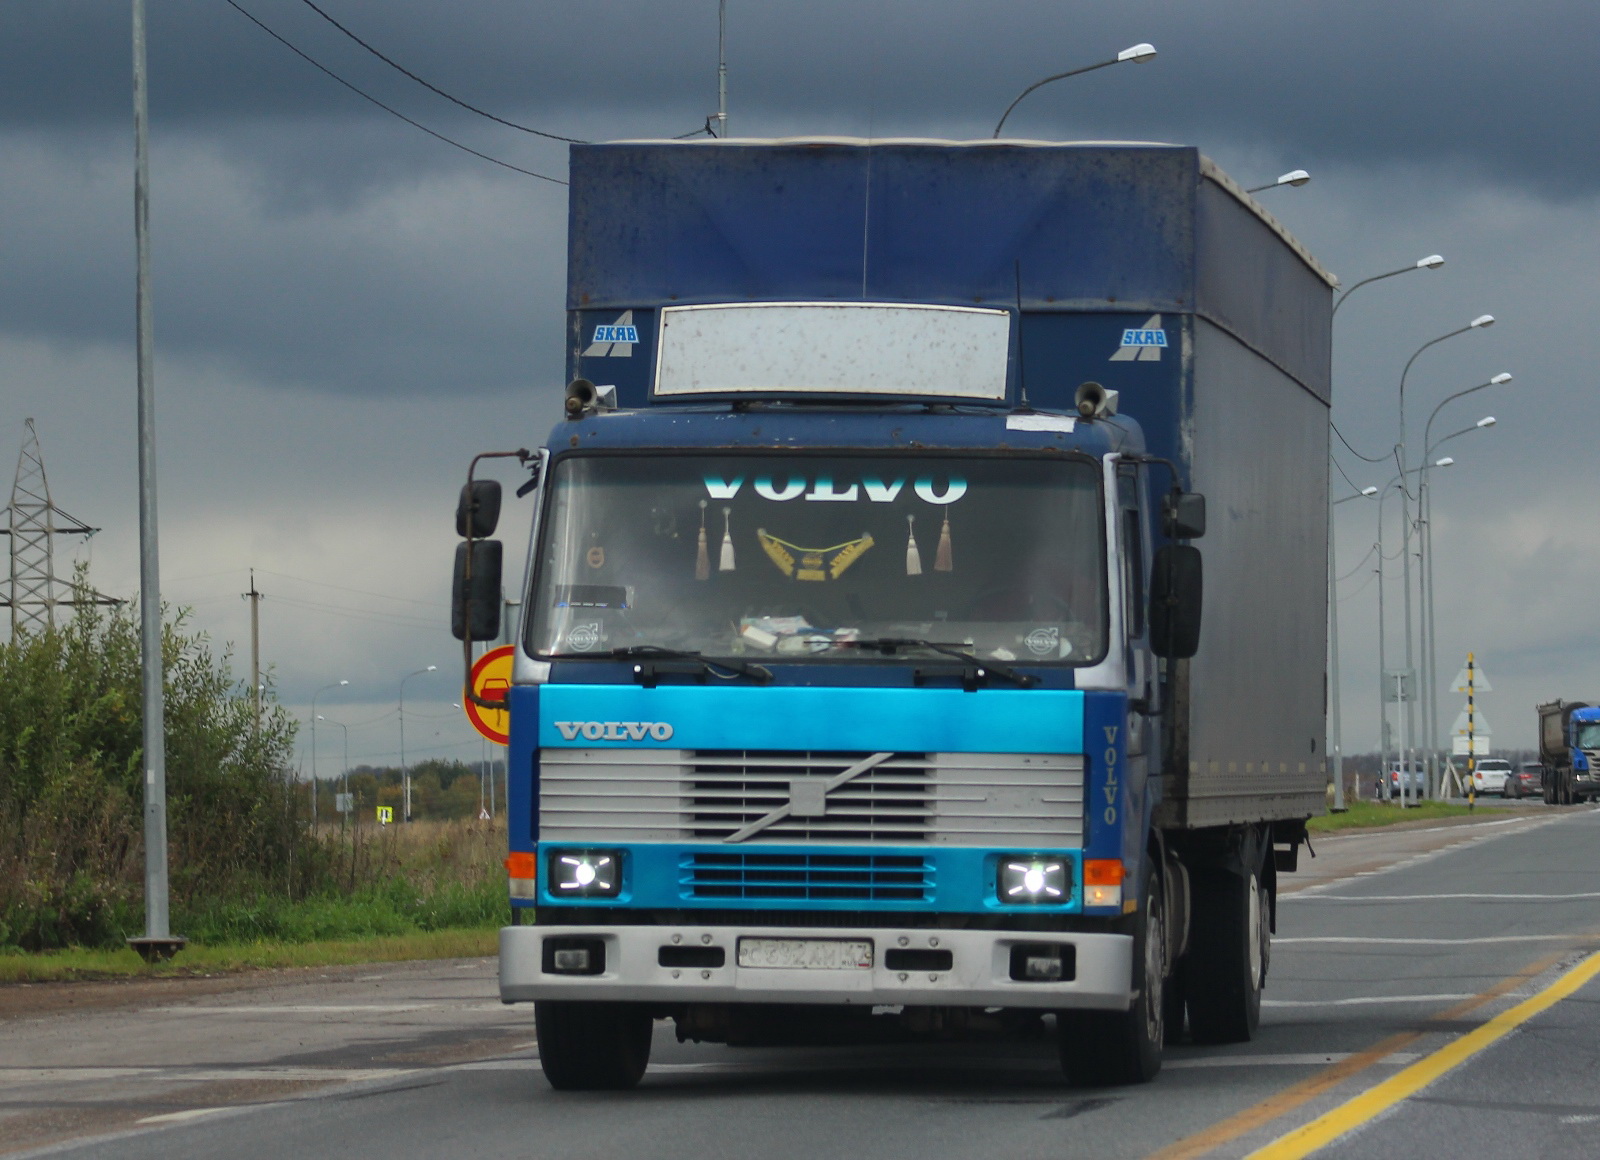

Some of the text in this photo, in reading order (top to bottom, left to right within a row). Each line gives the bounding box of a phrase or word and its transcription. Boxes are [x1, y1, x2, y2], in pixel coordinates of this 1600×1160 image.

[595, 327, 637, 341] SKAB
[1123, 331, 1165, 345] SKAB
[703, 473, 968, 505] VOLVO
[554, 721, 674, 741] VOLVO
[1103, 726, 1118, 825] VOLVO
